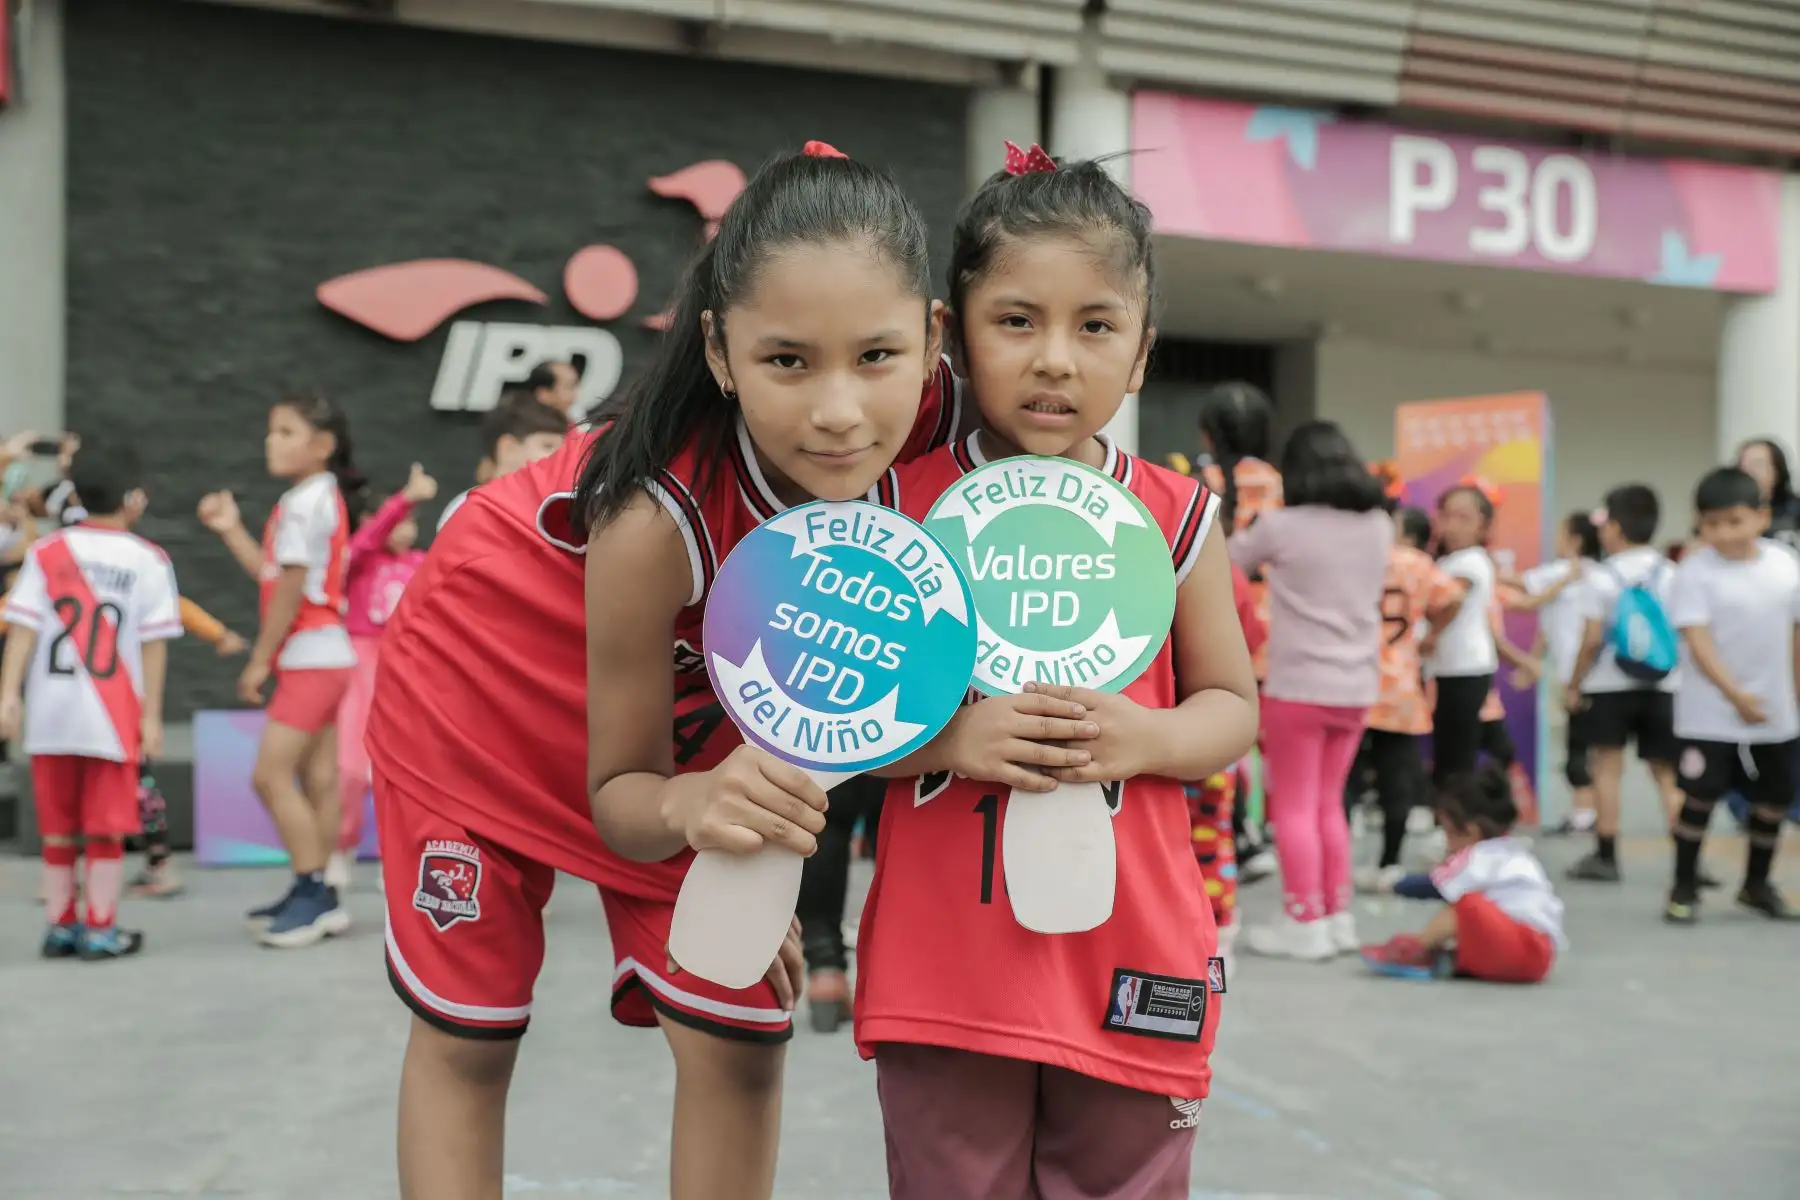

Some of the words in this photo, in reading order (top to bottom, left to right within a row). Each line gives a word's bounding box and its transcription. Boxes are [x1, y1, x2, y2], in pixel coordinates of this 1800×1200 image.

[1389, 134, 1458, 244] P
[1469, 146, 1597, 262] 30
[430, 321, 623, 420] IPD
[962, 469, 1047, 515] Feliz
[1057, 472, 1109, 519] Día
[798, 549, 916, 621] Todos
[805, 511, 894, 553] Feliz
[895, 539, 945, 599] Día
[966, 545, 1116, 581] Valores
[48, 597, 122, 677] 20
[768, 602, 906, 670] somos
[1009, 590, 1080, 627] IPD
[785, 651, 864, 706] IPD
[978, 640, 1024, 685] del
[1035, 643, 1117, 687] Niño
[738, 679, 792, 738] del
[793, 716, 884, 754] Niño
[425, 840, 480, 859] ACADEMIA
